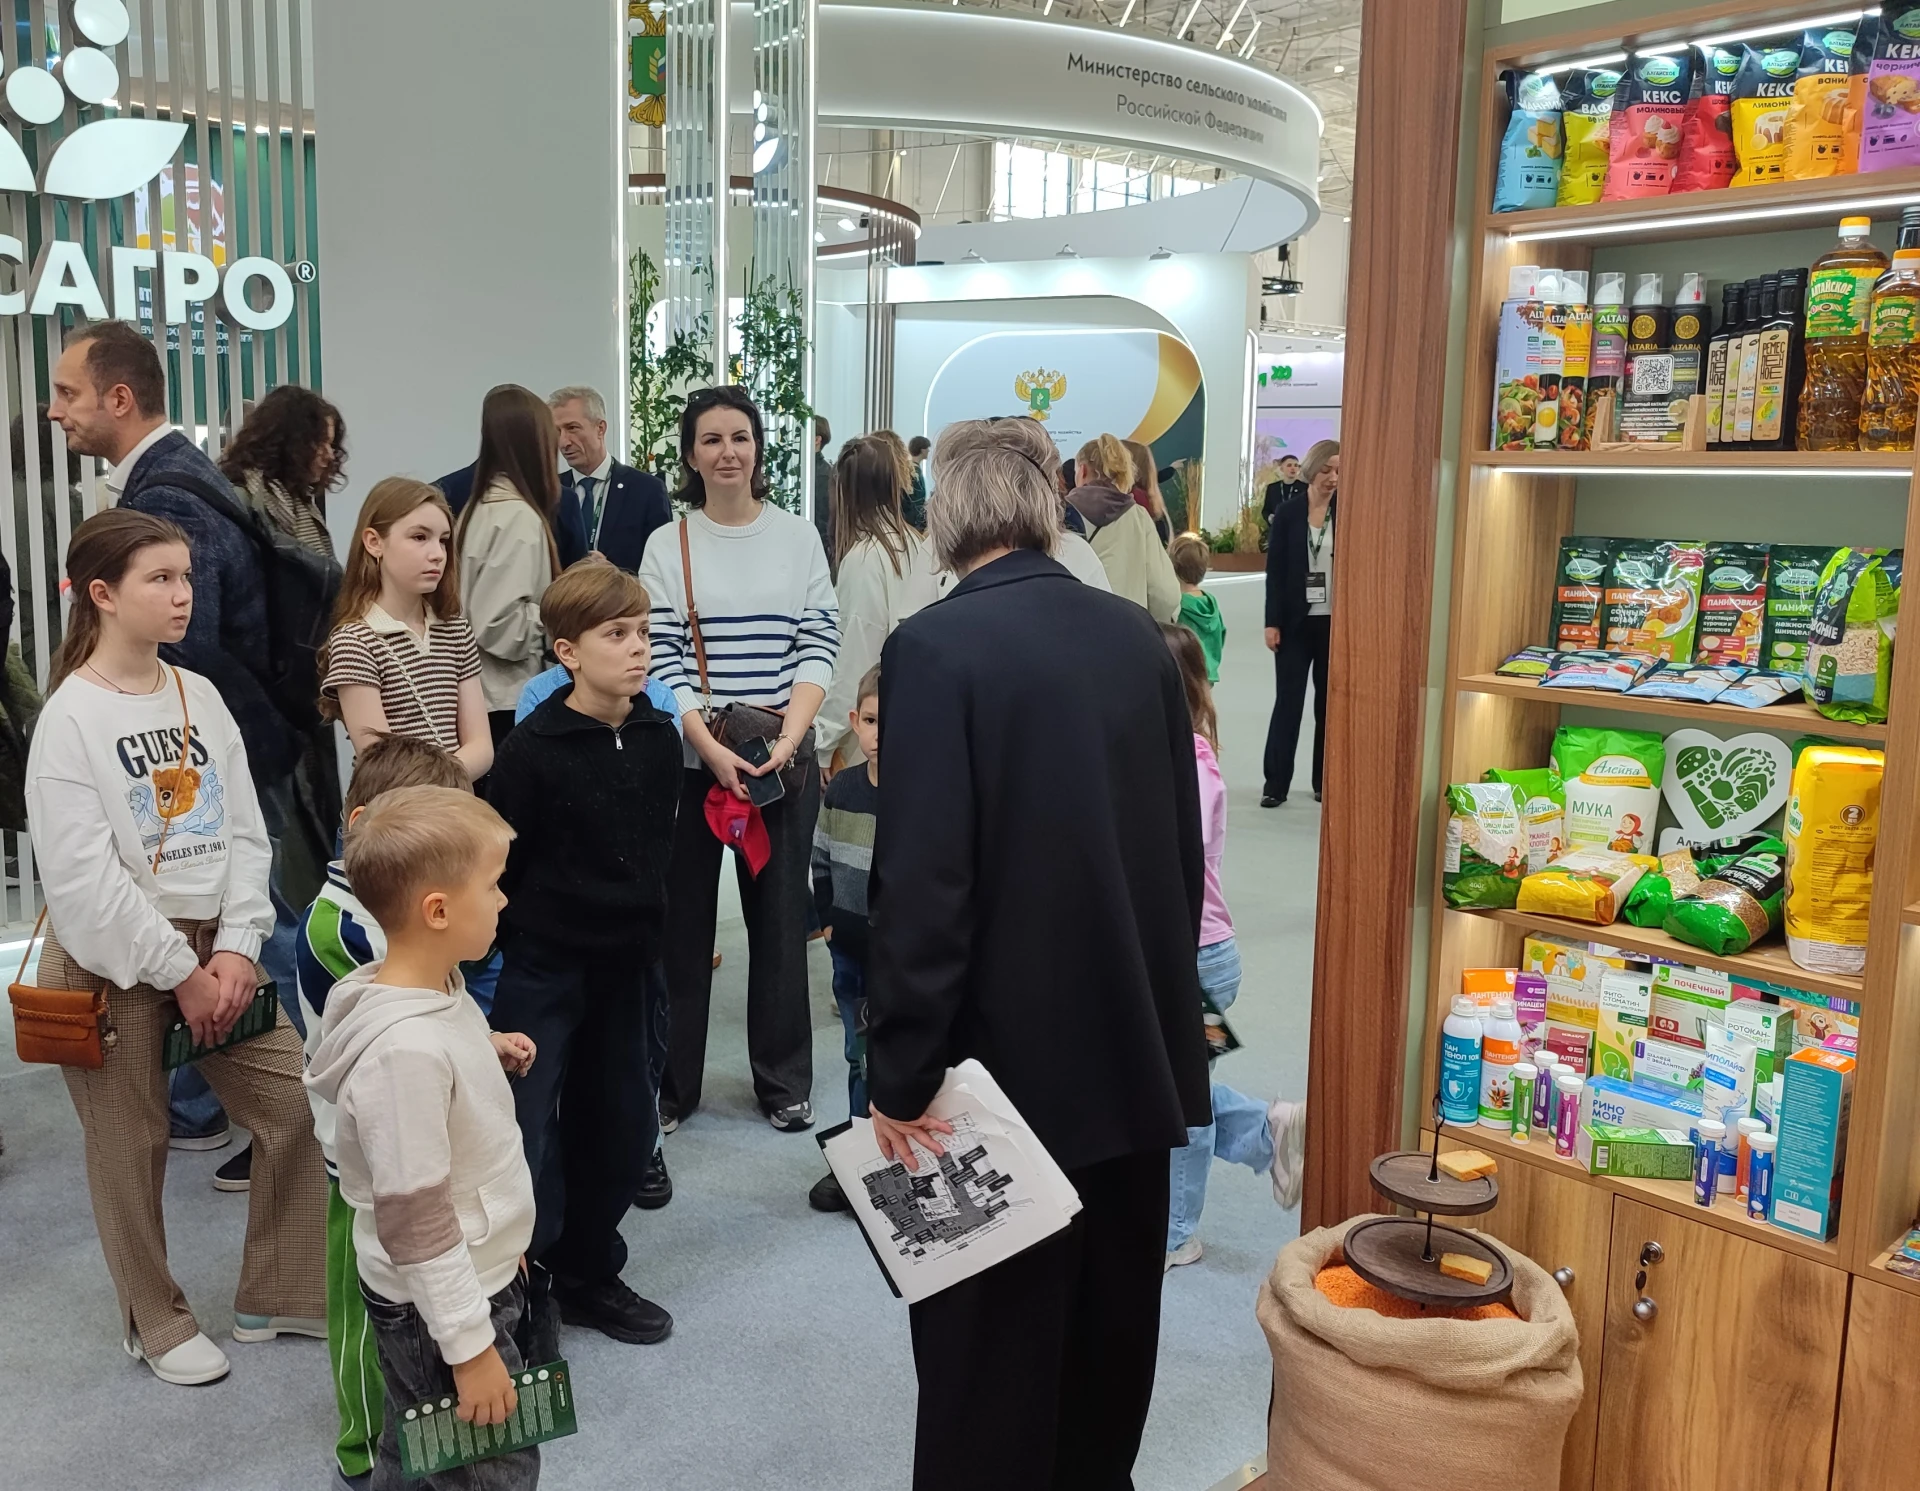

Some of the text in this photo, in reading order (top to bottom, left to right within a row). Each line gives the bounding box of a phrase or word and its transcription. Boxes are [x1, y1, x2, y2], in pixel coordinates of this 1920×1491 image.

[1067, 52, 1182, 88] Министерство
[1186, 78, 1245, 106] сельского
[1642, 90, 1682, 103] КЕКС
[1116, 94, 1265, 144] Российской Федерации
[1707, 598, 1758, 607] ПАНИРОВКА
[116, 724, 209, 779] GUESS
[1593, 760, 1641, 775] Алейка
[1572, 800, 1613, 819] МУКА
[1848, 808, 1859, 819] 2
[193, 840, 227, 856] EST.1981
[1603, 990, 1626, 999] ФИТО-
[1674, 978, 1725, 996] ПОЧЕЧНЫЙ
[1602, 996, 1640, 1008] СТОМАТИН
[1727, 1022, 1771, 1038] РОТОКАН-
[1444, 1042, 1458, 1052] ПАН
[1444, 1050, 1466, 1061] ТЕНОЛ
[1484, 1049, 1518, 1061] ПАНТЕНОЛ
[1559, 1054, 1584, 1064] АЛТЕЯ
[1592, 1099, 1625, 1116] РИНО
[1592, 1109, 1623, 1124] МОРЕ
